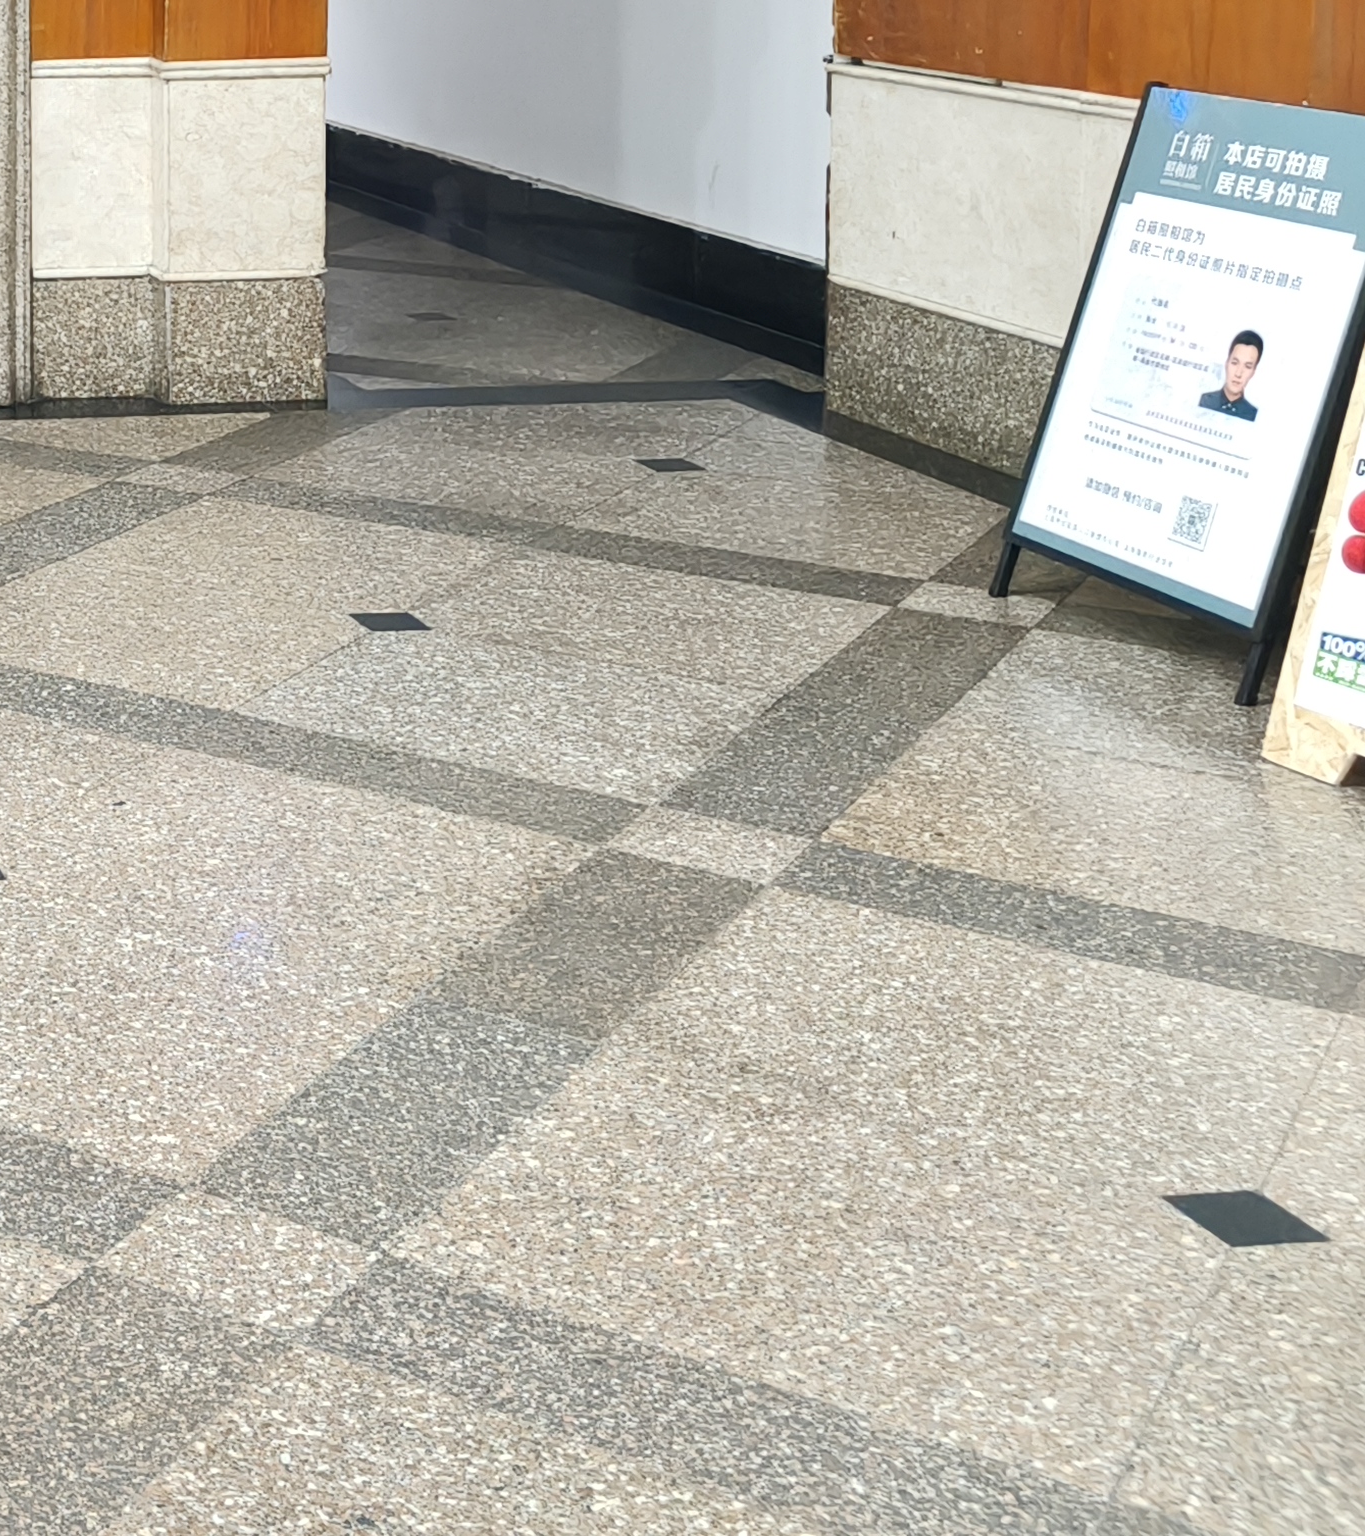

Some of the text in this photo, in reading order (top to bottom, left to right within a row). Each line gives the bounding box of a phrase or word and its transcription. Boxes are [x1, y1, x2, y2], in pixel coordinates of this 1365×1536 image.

[1168, 129, 1214, 163] 白箱
[1223, 140, 1330, 182] 本店可拍摄
[1162, 160, 1199, 181] 照相馆
[1213, 171, 1343, 217] 居民身份证照
